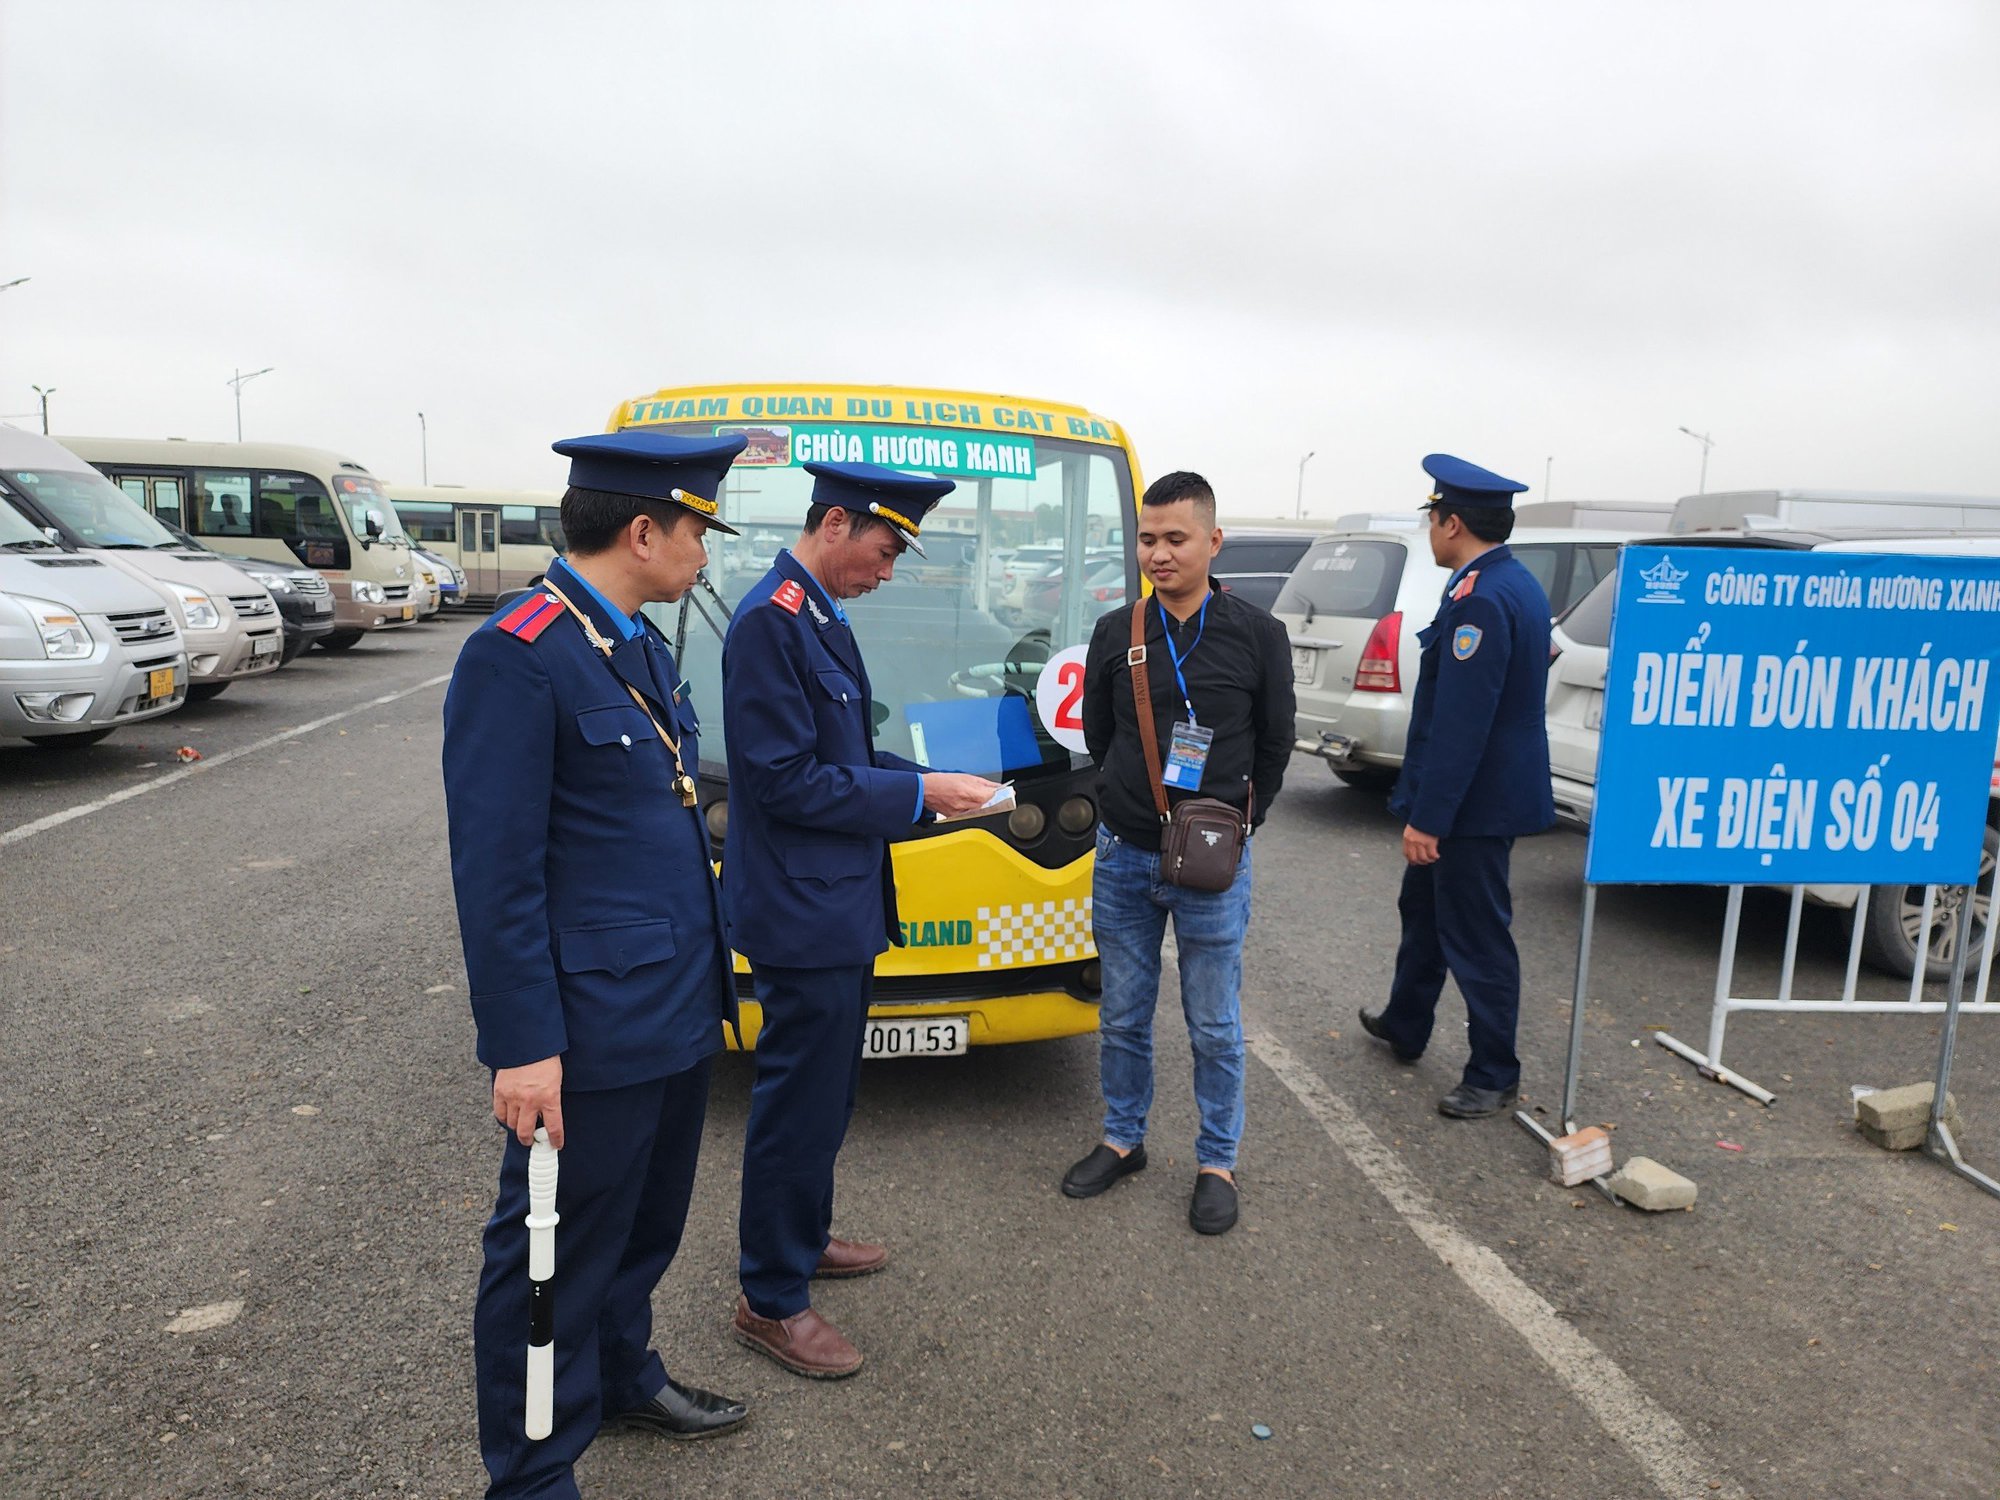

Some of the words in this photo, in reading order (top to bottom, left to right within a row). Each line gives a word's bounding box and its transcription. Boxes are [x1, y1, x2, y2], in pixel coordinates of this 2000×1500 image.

[631, 397, 730, 422] THAM
[741, 397, 832, 418] QUAN
[846, 398, 892, 418] DU
[905, 401, 982, 425] LỊCH
[795, 429, 864, 463] CHÙA
[872, 435, 959, 469] HƯƠNG
[965, 442, 1032, 475] XANH
[1704, 566, 1767, 606] CÔNG
[1773, 574, 1801, 607] TY
[1804, 569, 1862, 609] CHÙA
[1867, 574, 1943, 611] HƯƠNG
[1630, 621, 1744, 728] ĐIỂM
[1750, 640, 1842, 730] ĐÓN
[1847, 642, 1990, 732] KHÁCH
[1650, 776, 1709, 848] XE
[1716, 763, 1818, 866] ĐIỆN
[1824, 754, 1891, 852] SỐ
[1890, 781, 1941, 852] 04
[889, 920, 972, 947] SLAND
